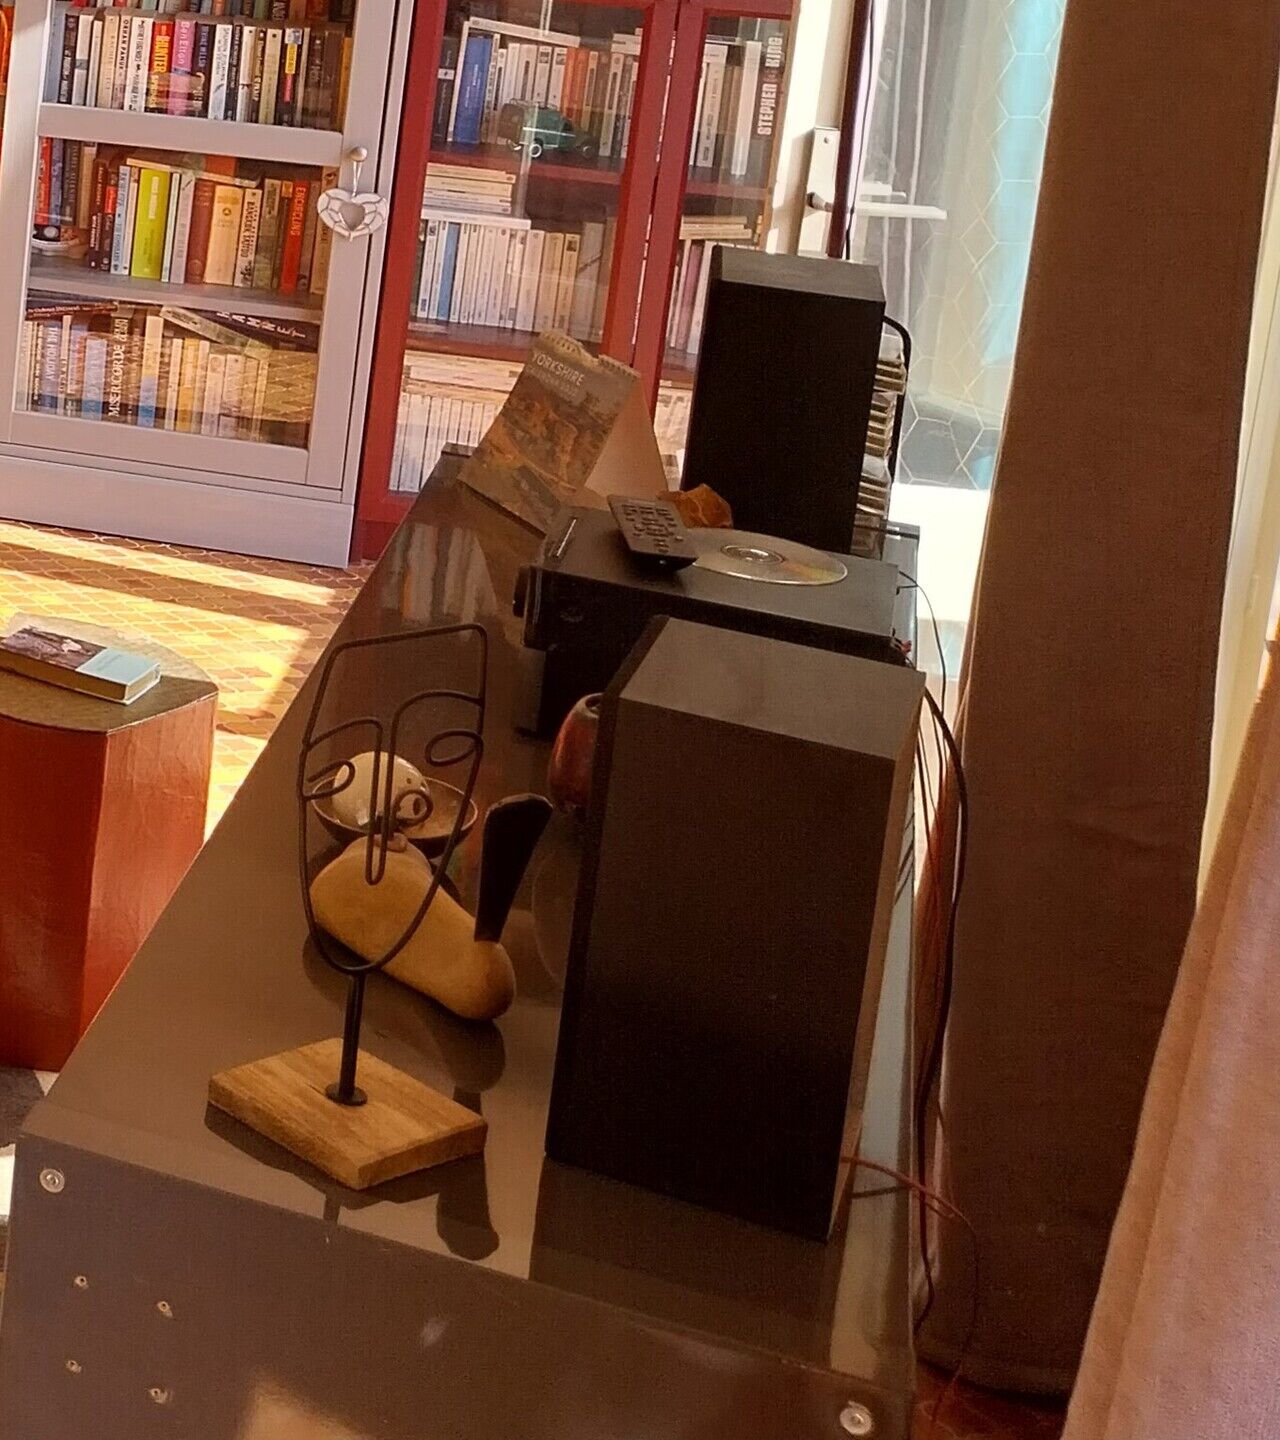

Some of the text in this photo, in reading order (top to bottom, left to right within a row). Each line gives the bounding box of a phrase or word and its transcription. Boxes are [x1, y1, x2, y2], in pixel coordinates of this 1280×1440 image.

[118, 19, 129, 71] ORHAN PAMUK
[177, 21, 190, 64] Ben Elton
[757, 36, 783, 135] STEPHEN KING
[290, 187, 306, 236] ENCIRCLING
[44, 327, 58, 381] THE HOLIDAY
[532, 351, 585, 386] YORKSHIRE
